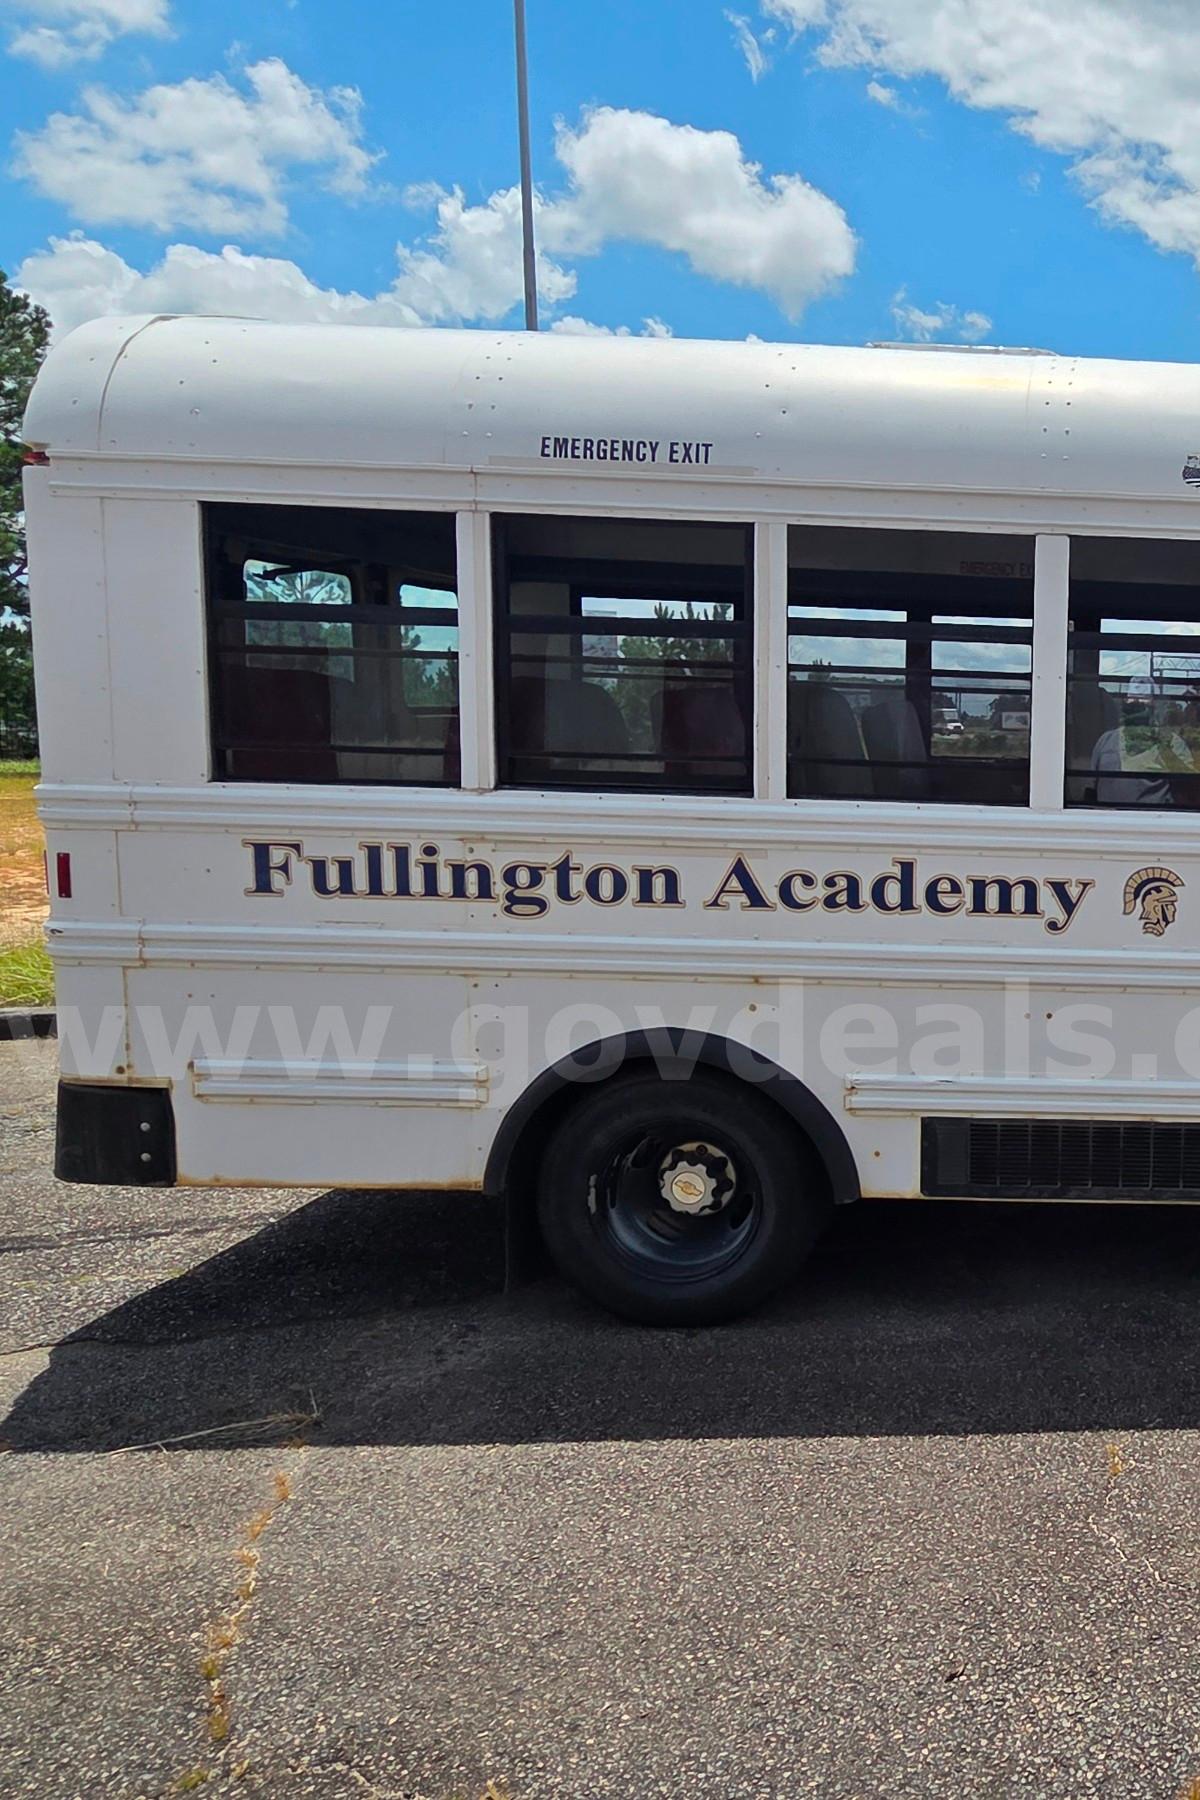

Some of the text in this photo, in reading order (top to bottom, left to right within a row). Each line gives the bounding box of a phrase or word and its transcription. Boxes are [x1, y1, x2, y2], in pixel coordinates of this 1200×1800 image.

[540, 436, 713, 465] EMERGENCY EXIT
[242, 838, 1097, 935] Fullington Academy
